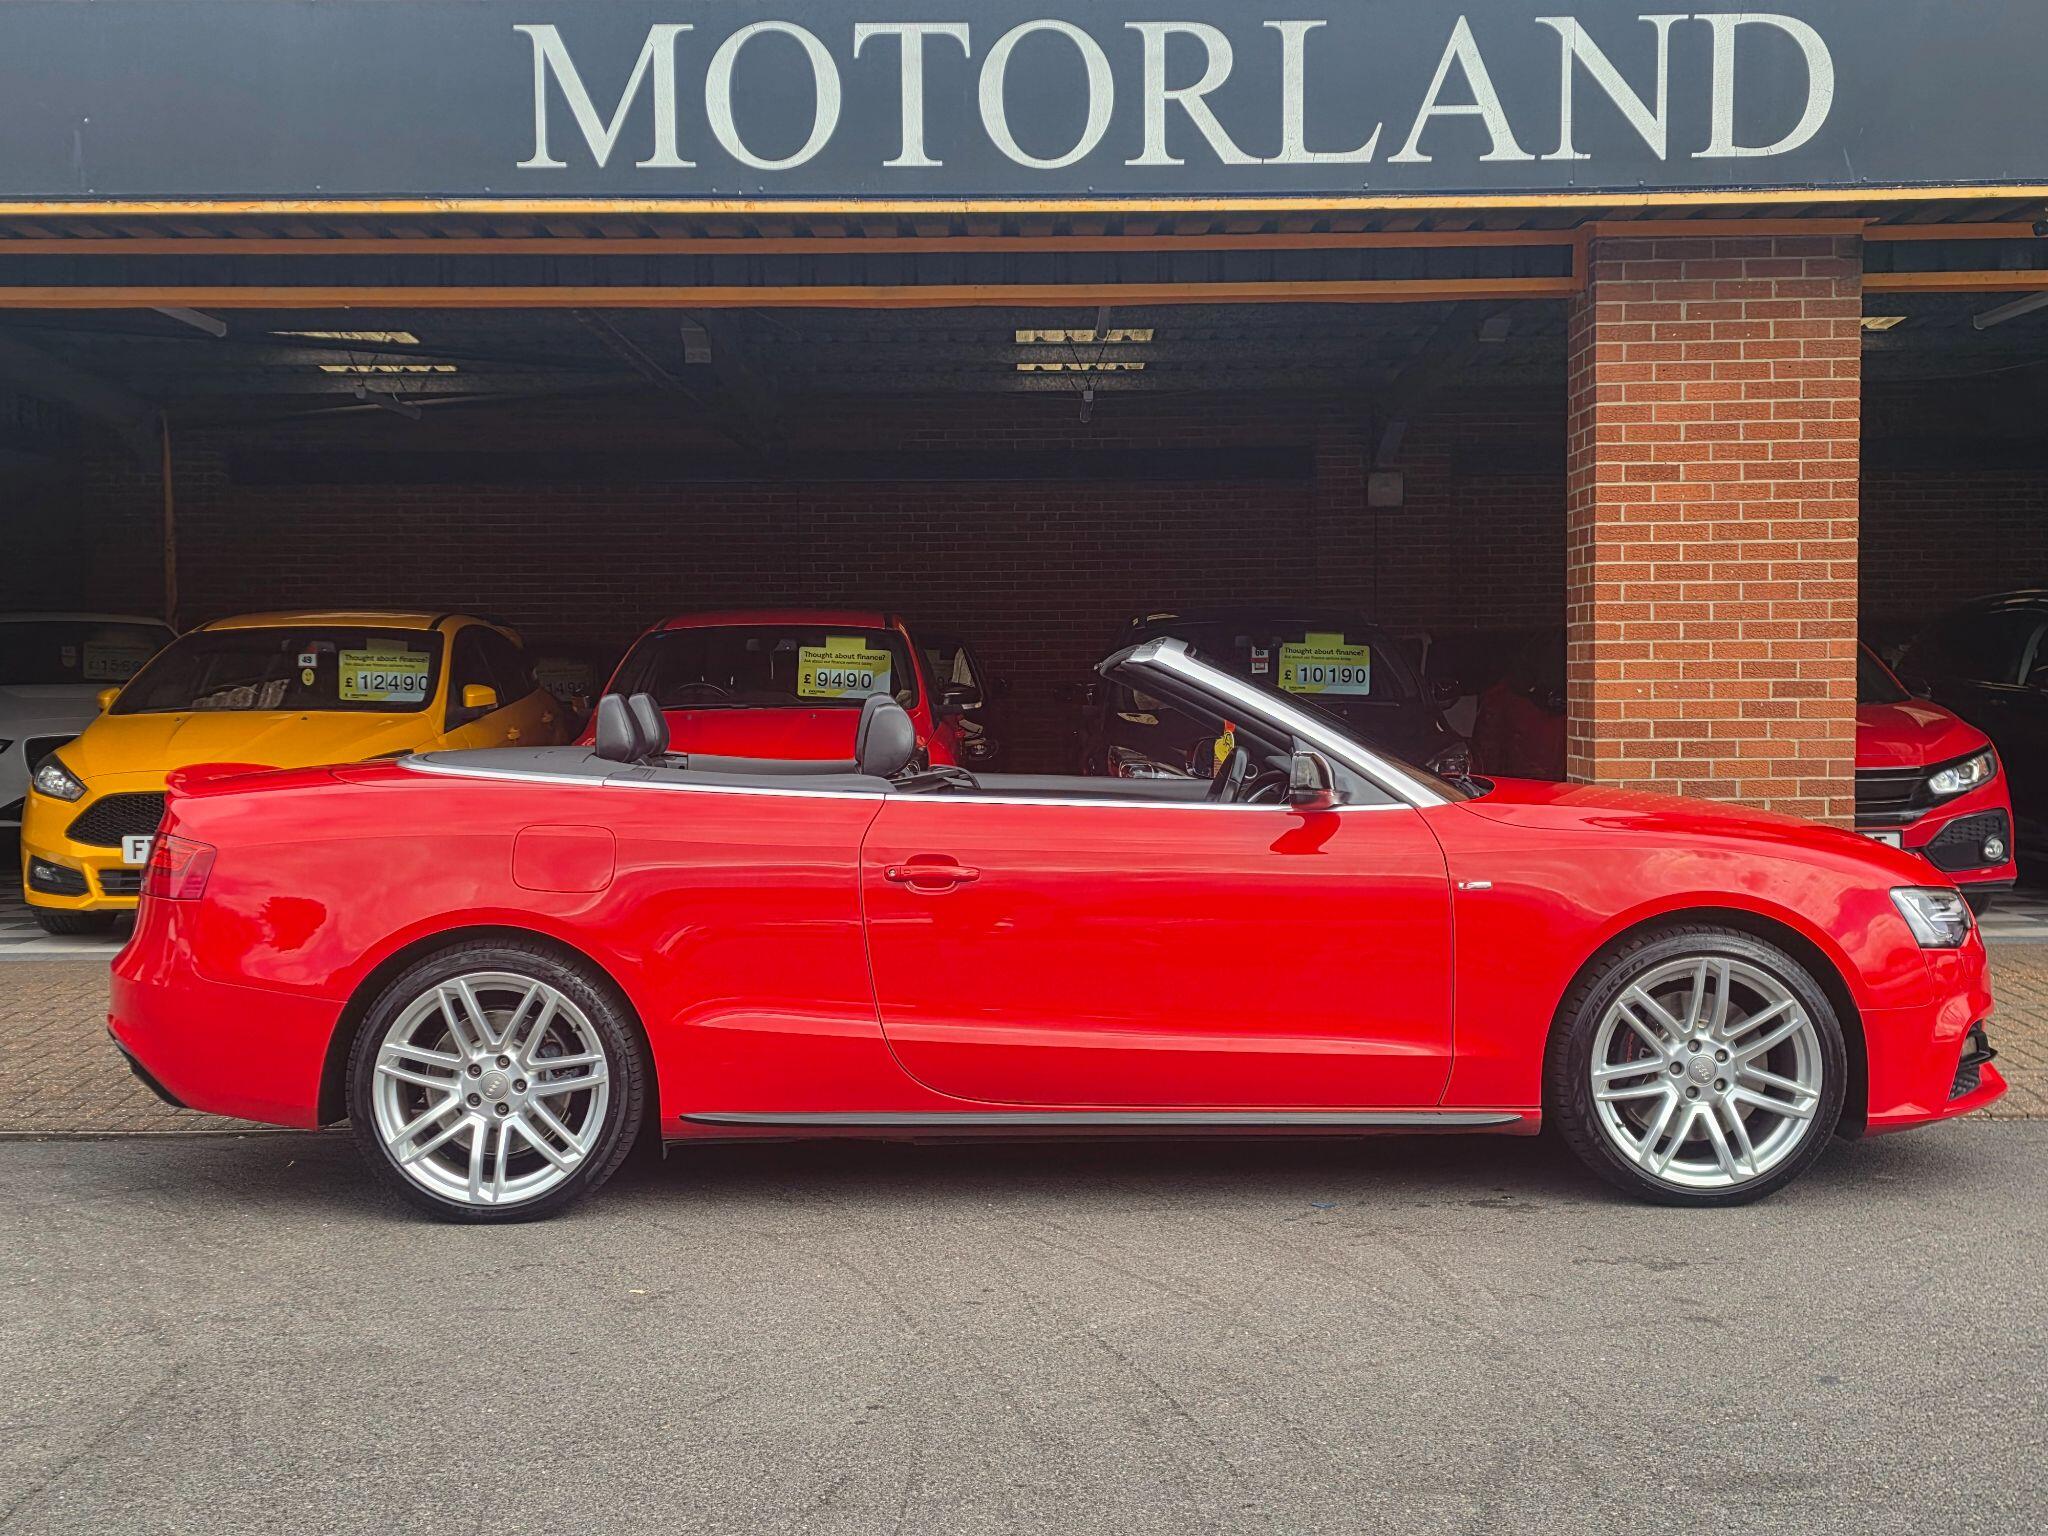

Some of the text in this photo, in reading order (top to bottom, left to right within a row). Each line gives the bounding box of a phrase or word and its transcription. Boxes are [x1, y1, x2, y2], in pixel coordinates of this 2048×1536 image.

[513, 13, 1835, 170] MOTORLAND
[804, 651, 833, 660] Thought
[834, 652, 855, 660] about
[1284, 647, 1313, 655] Thought
[345, 674, 428, 691] £ 12490
[804, 671, 873, 689] £ 9490
[1284, 667, 1366, 684] £ 10190
